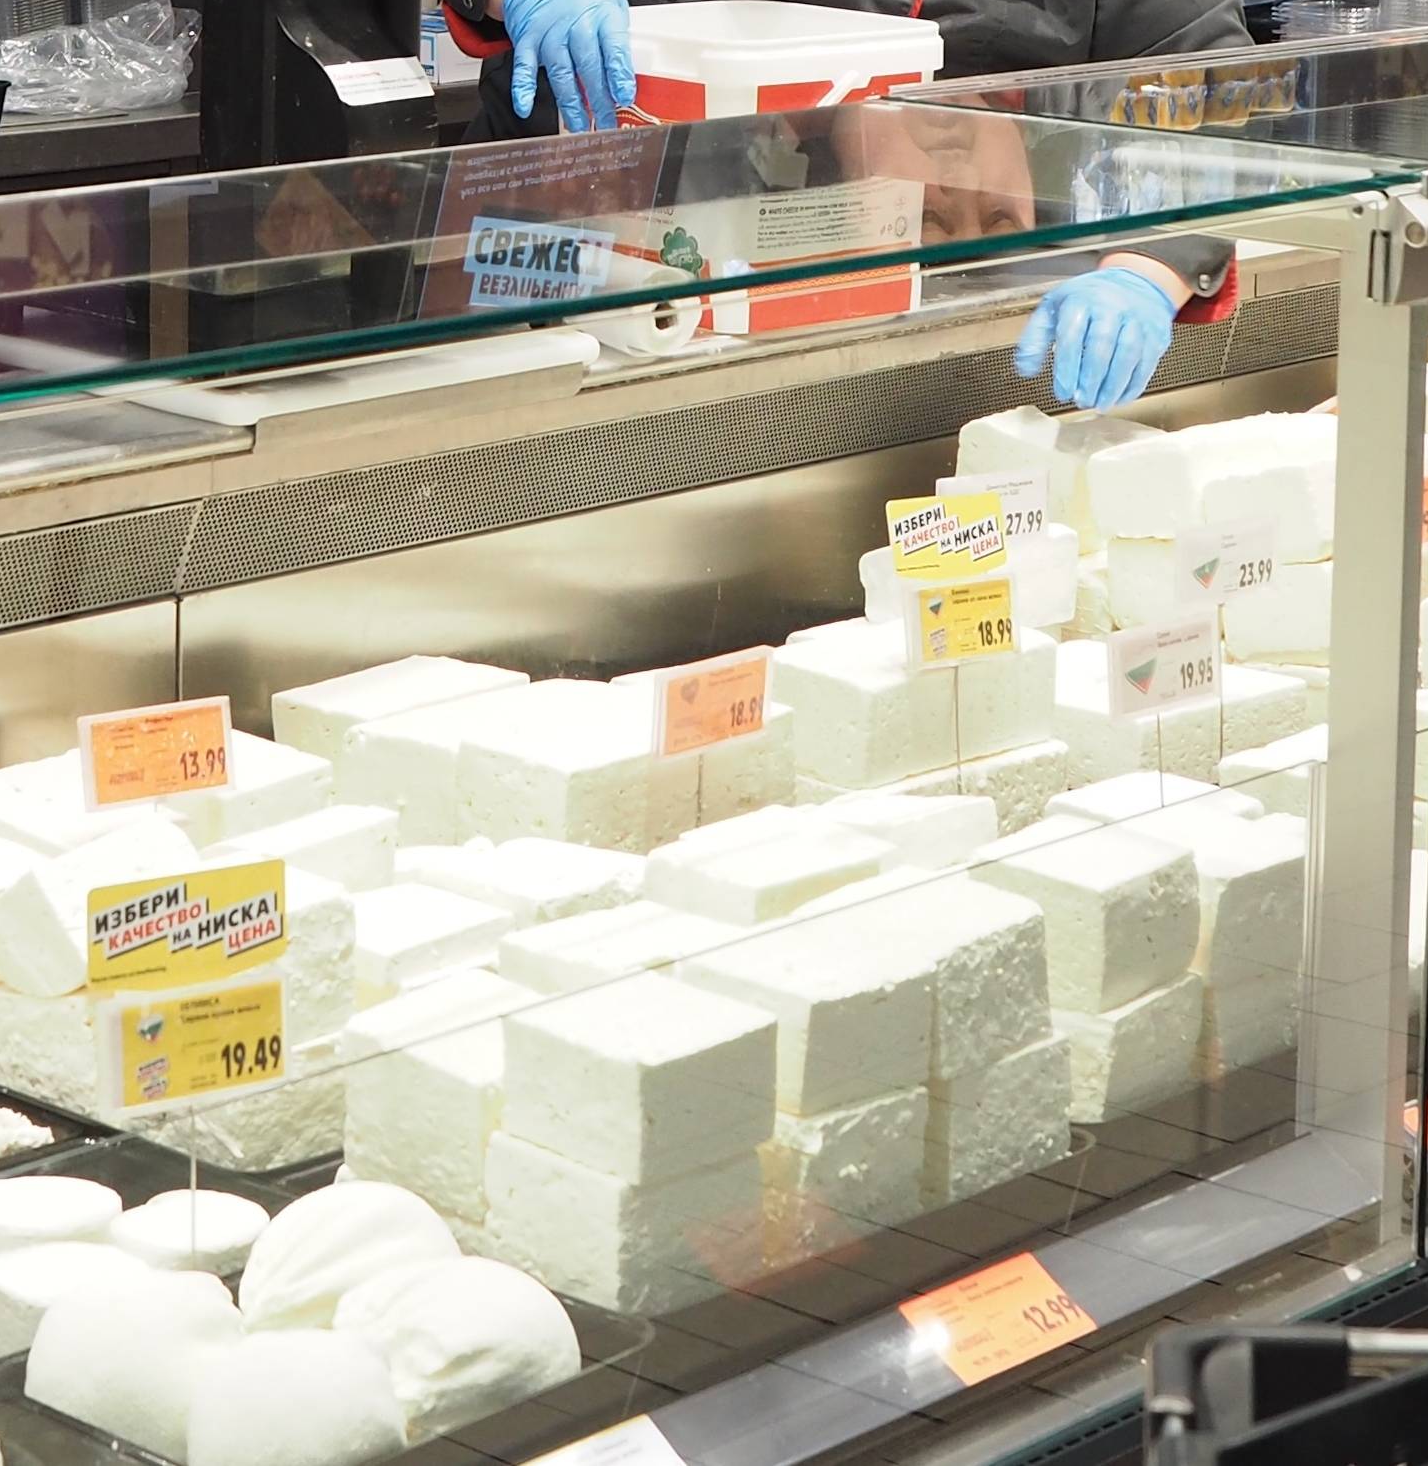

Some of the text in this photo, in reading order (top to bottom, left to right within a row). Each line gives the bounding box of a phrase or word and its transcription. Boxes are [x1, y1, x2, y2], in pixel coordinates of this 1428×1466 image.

[895, 507, 942, 537] ИЗБЕРИ
[903, 520, 955, 549] КАЧЕСТВО
[941, 520, 994, 549] НА НИСКА
[1006, 510, 1043, 536] 27.99
[973, 536, 999, 555] ЦЕНА
[1239, 558, 1272, 588] 23.99
[978, 619, 1012, 647] 18.99
[1180, 657, 1213, 689] 19.95
[180, 746, 226, 780] 13.99
[94, 887, 179, 935] ИЗБЕРИ
[108, 903, 202, 950] КАЧЕСТВО
[173, 898, 269, 943] НА НИСКА
[228, 918, 276, 949] ЦЕНА
[221, 1034, 282, 1078] 19.49
[1023, 1294, 1081, 1333] 12.99
